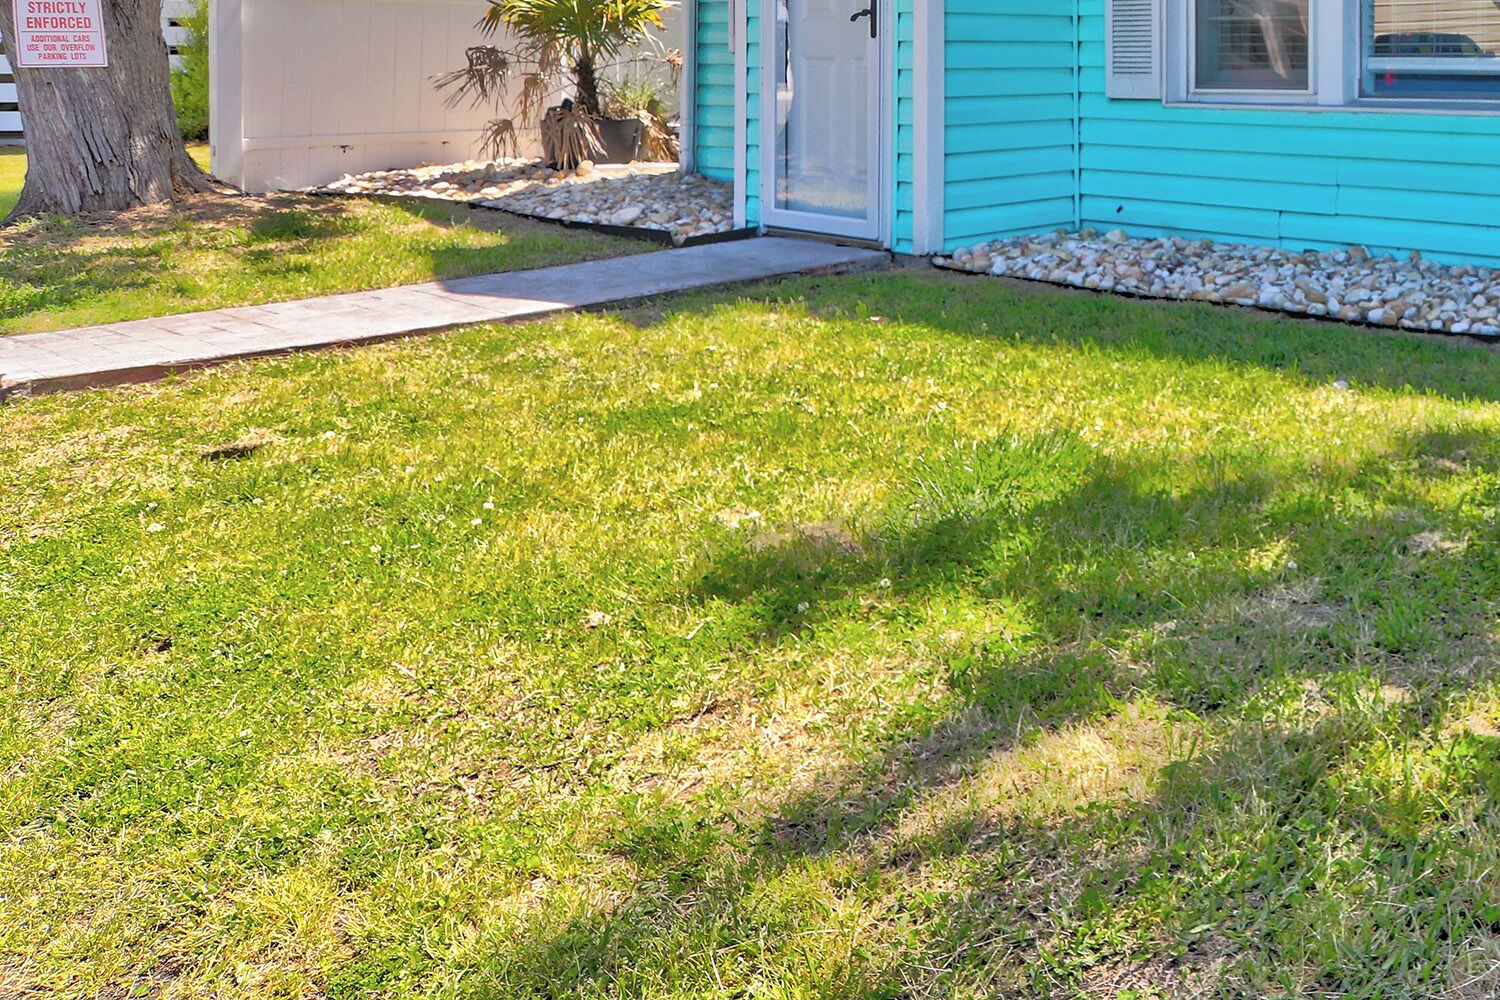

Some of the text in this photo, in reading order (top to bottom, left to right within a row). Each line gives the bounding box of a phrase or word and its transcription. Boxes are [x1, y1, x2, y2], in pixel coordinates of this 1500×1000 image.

[28, 2, 86, 13] STRICTLY
[26, 17, 91, 28] ENFORCED
[31, 34, 90, 43] ADDITIONAL CARS
[60, 44, 95, 52] OVERFLOW
[38, 52, 87, 60] PARKING LOTS
